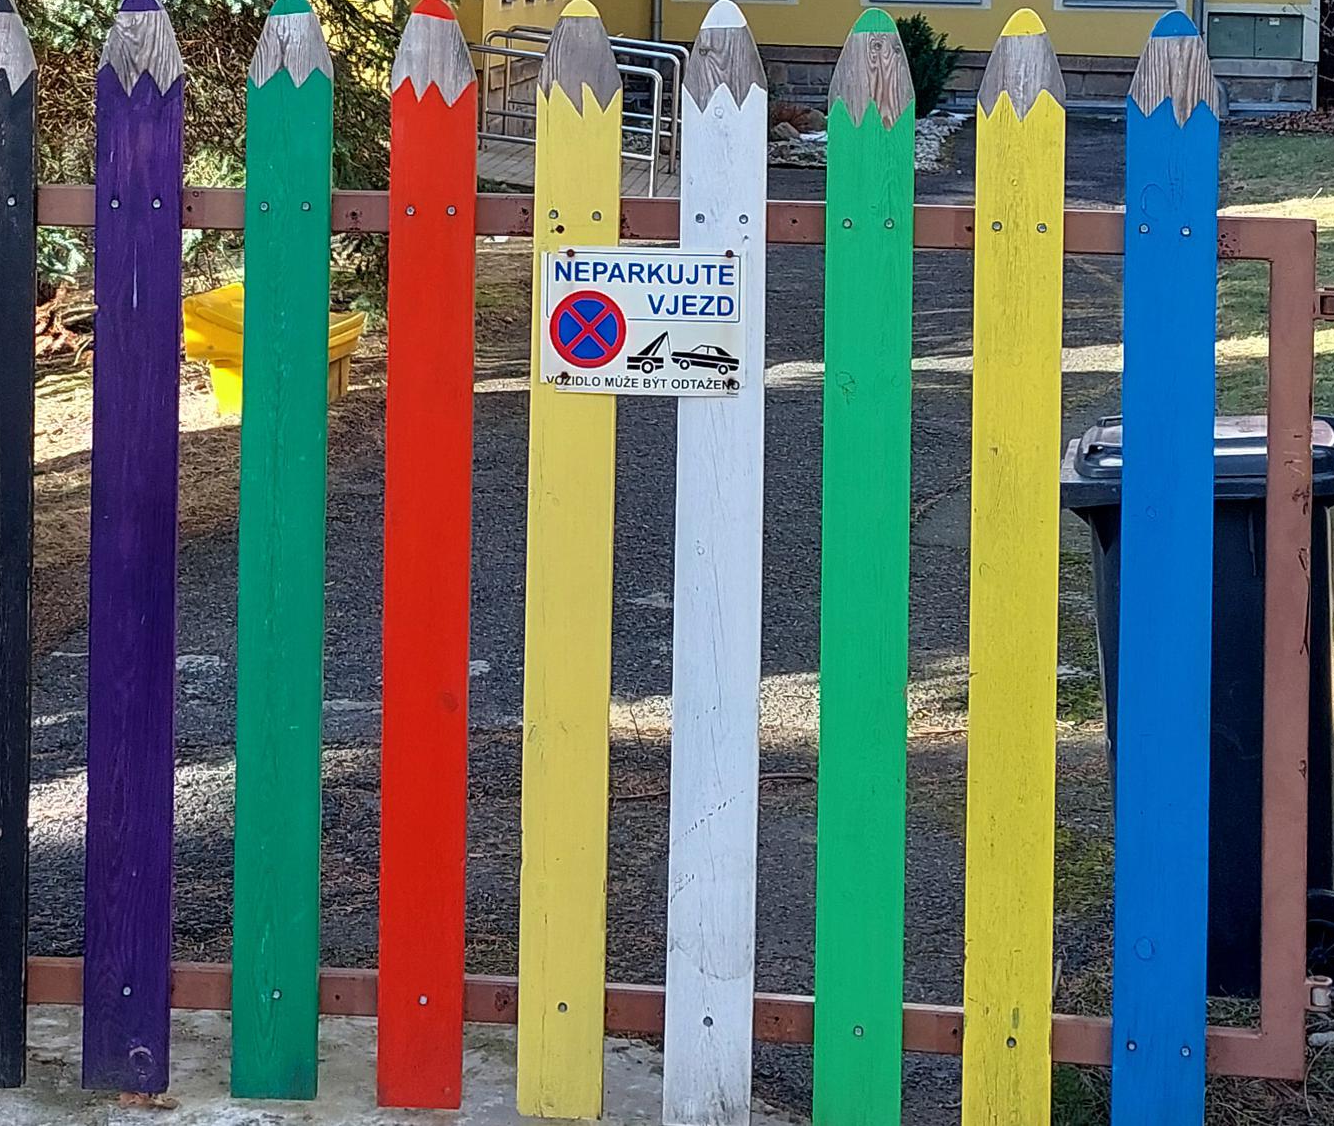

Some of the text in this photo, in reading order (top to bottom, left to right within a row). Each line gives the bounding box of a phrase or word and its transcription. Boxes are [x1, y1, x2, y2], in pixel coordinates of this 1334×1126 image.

[554, 261, 735, 286] NEPARKUJTE
[648, 293, 734, 316] VJEZD
[546, 375, 740, 391] VOZIDLO MŮŽE BÝT ODTAŽENO
